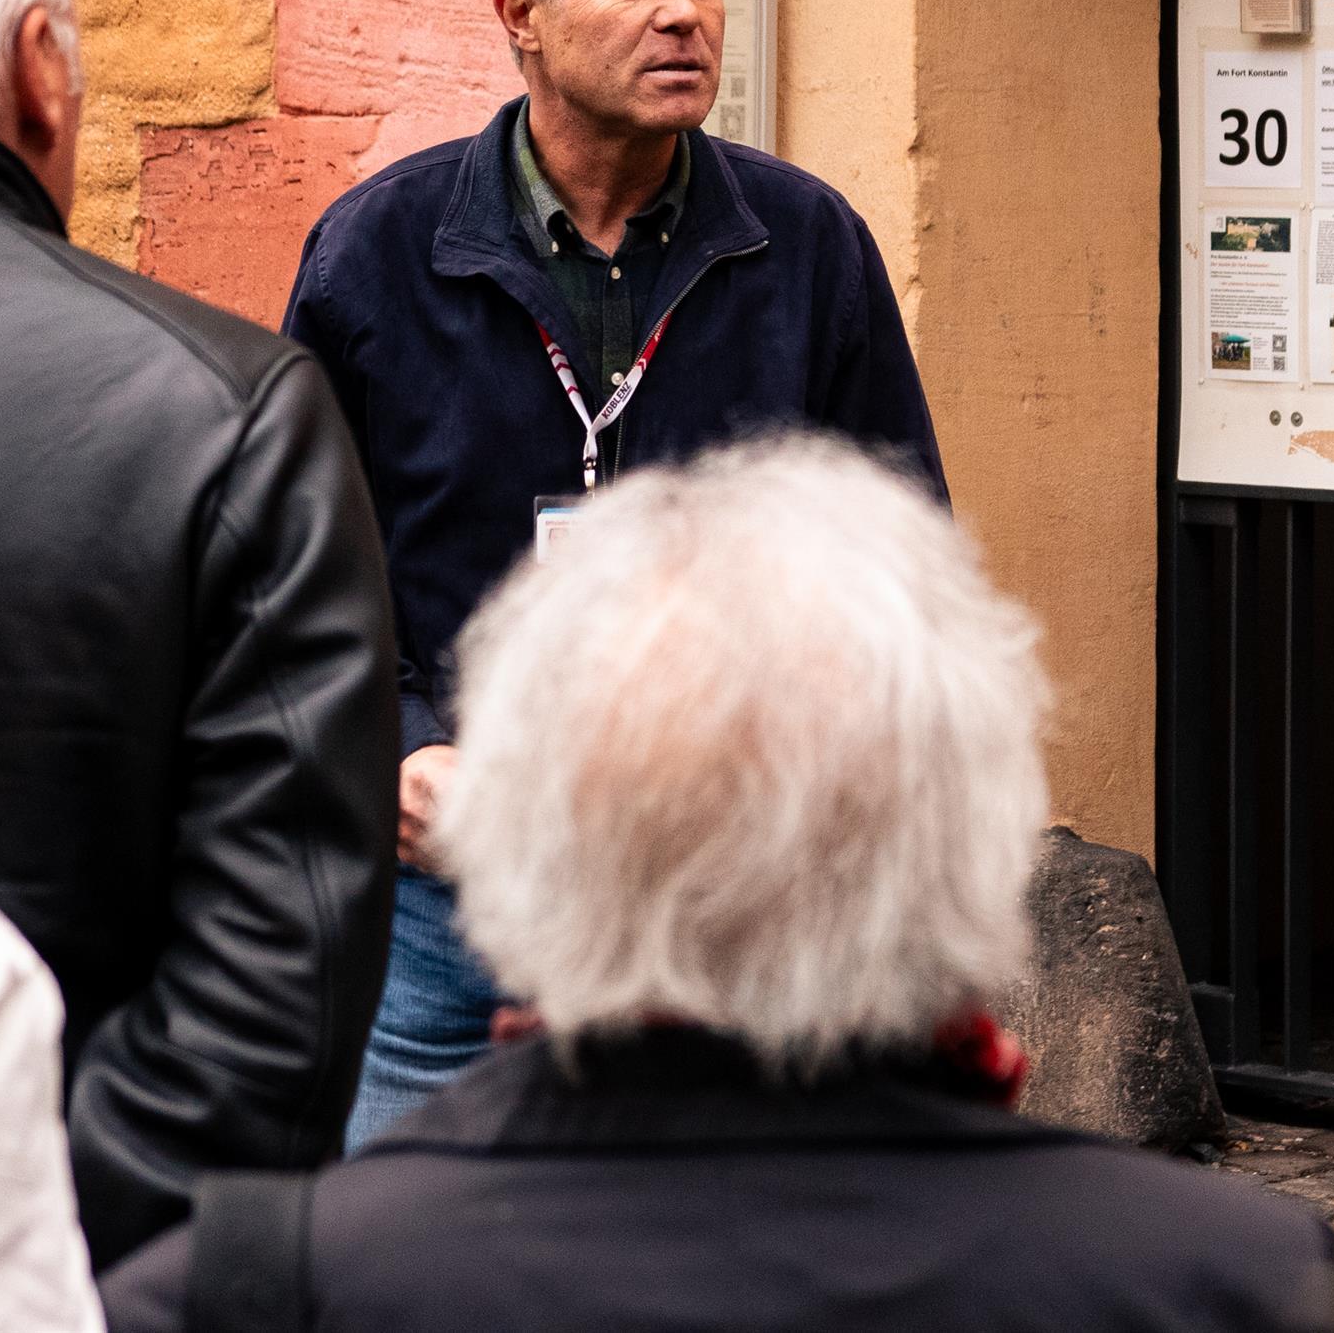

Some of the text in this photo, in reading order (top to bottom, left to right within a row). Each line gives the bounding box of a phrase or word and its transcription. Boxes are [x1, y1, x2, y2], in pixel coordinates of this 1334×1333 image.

[1216, 68, 1288, 77] Am Fort Konstantin
[1219, 108, 1288, 167] 30
[601, 381, 631, 420] KOBLENZ
